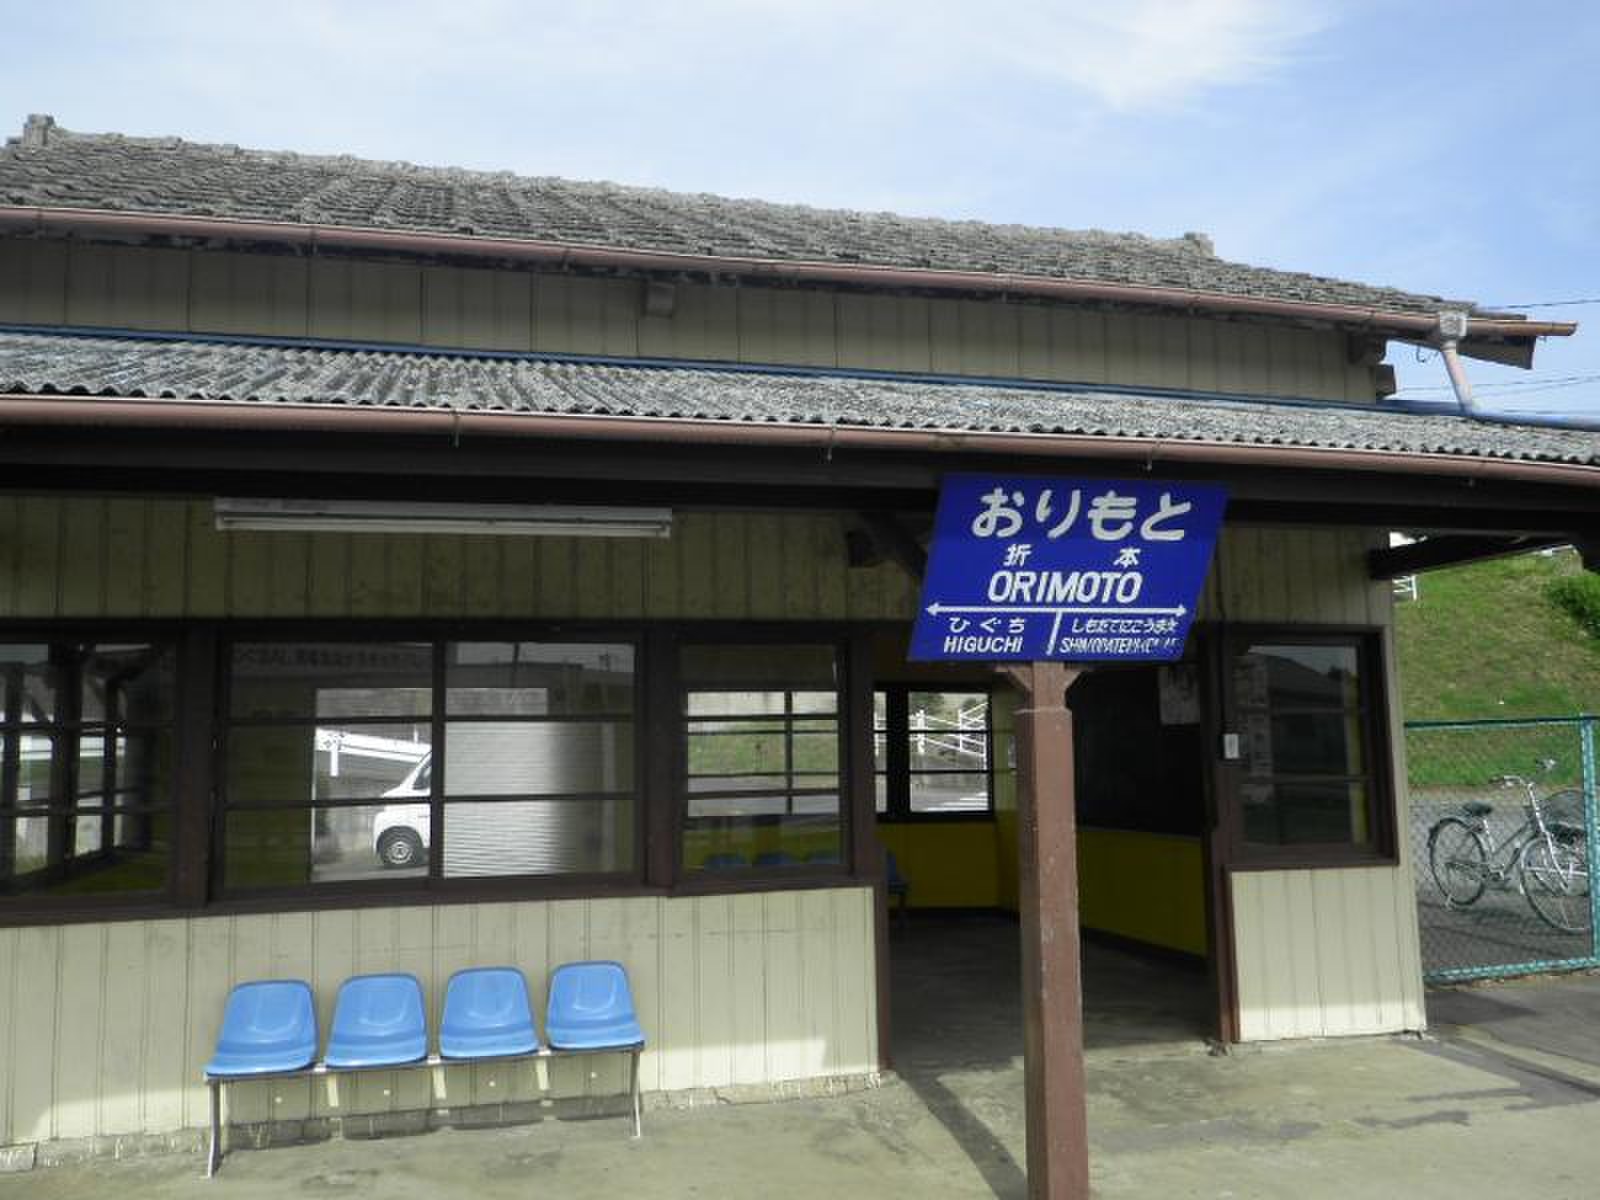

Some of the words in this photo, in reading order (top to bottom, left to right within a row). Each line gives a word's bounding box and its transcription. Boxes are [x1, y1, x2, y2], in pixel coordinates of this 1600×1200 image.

[972, 487, 1191, 541] おりもと
[988, 571, 1142, 603] ORIMOTO
[949, 617, 1025, 633] ひぐち
[944, 636, 1024, 653] HIGUCHI
